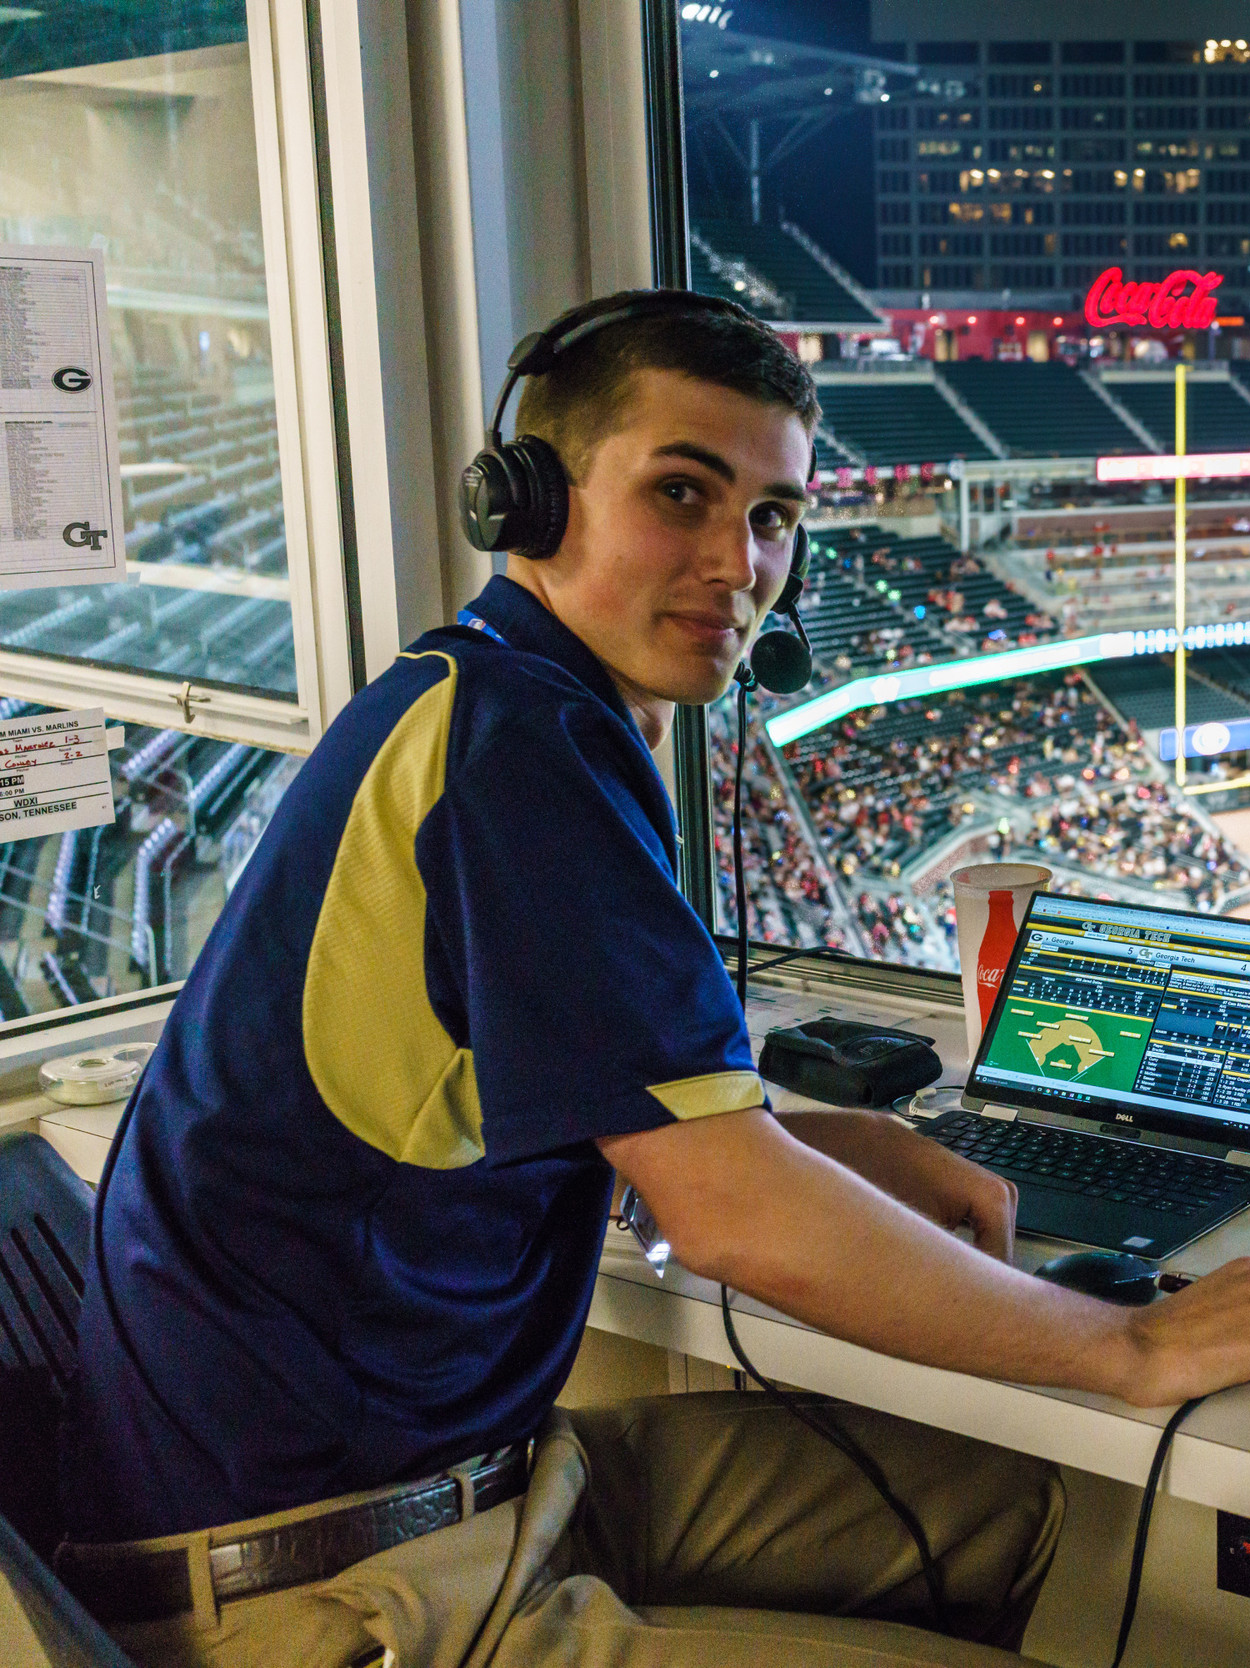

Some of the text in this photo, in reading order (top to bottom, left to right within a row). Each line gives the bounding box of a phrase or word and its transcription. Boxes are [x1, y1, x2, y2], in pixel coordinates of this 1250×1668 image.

[53, 368, 91, 392] G
[63, 521, 108, 551] GT
[8, 726, 30, 737] MIAMI
[46, 720, 79, 731] MARLINS
[12, 776, 24, 786] PM
[14, 797, 38, 808] WDXI
[23, 802, 77, 817] TENNESSEE
[1031, 933, 1043, 942] G
[1099, 923, 1140, 938] GEORGIA
[1145, 930, 1171, 942] TECH
[1051, 936, 1134, 955] Georgia 5
[1156, 952, 1247, 972] Georgia Tech 4
[977, 964, 1004, 988] Coca-
[1116, 1113, 1133, 1122] DELL
